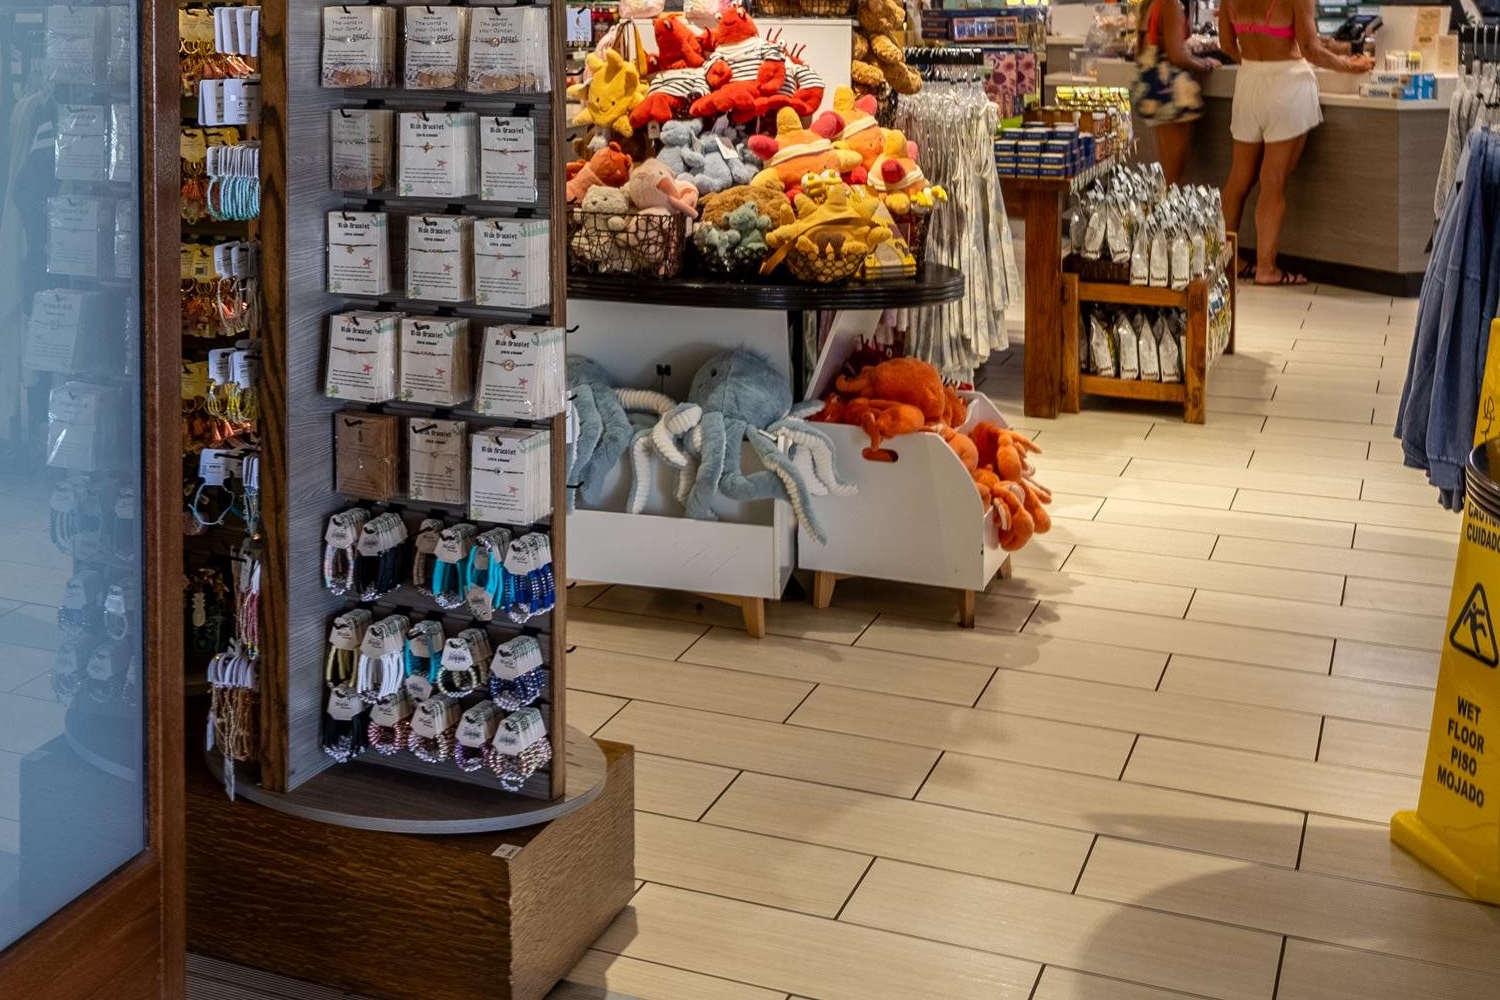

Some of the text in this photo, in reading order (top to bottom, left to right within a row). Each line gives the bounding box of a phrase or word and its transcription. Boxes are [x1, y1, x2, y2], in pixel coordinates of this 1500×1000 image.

[1457, 696, 1481, 725] WET
[1447, 717, 1485, 755] FLOOR
[1451, 745, 1477, 777] PISO
[1437, 764, 1484, 808] MOJADO
